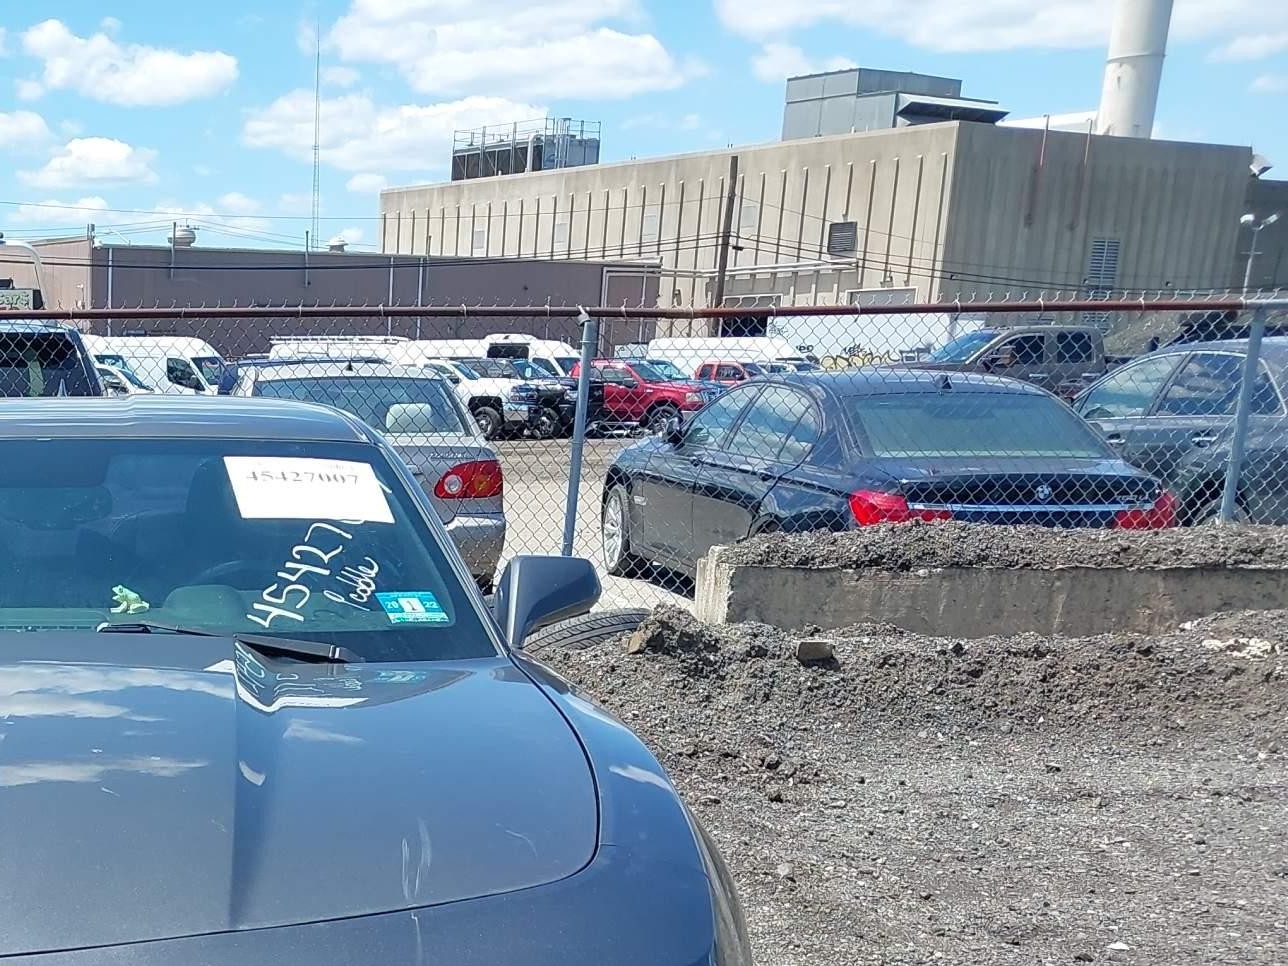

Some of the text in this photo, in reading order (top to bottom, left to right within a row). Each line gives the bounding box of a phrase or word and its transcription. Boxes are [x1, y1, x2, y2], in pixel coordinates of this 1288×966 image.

[246, 518, 364, 628] 45427
[384, 600, 400, 610] 20
[423, 600, 440, 610] 22
